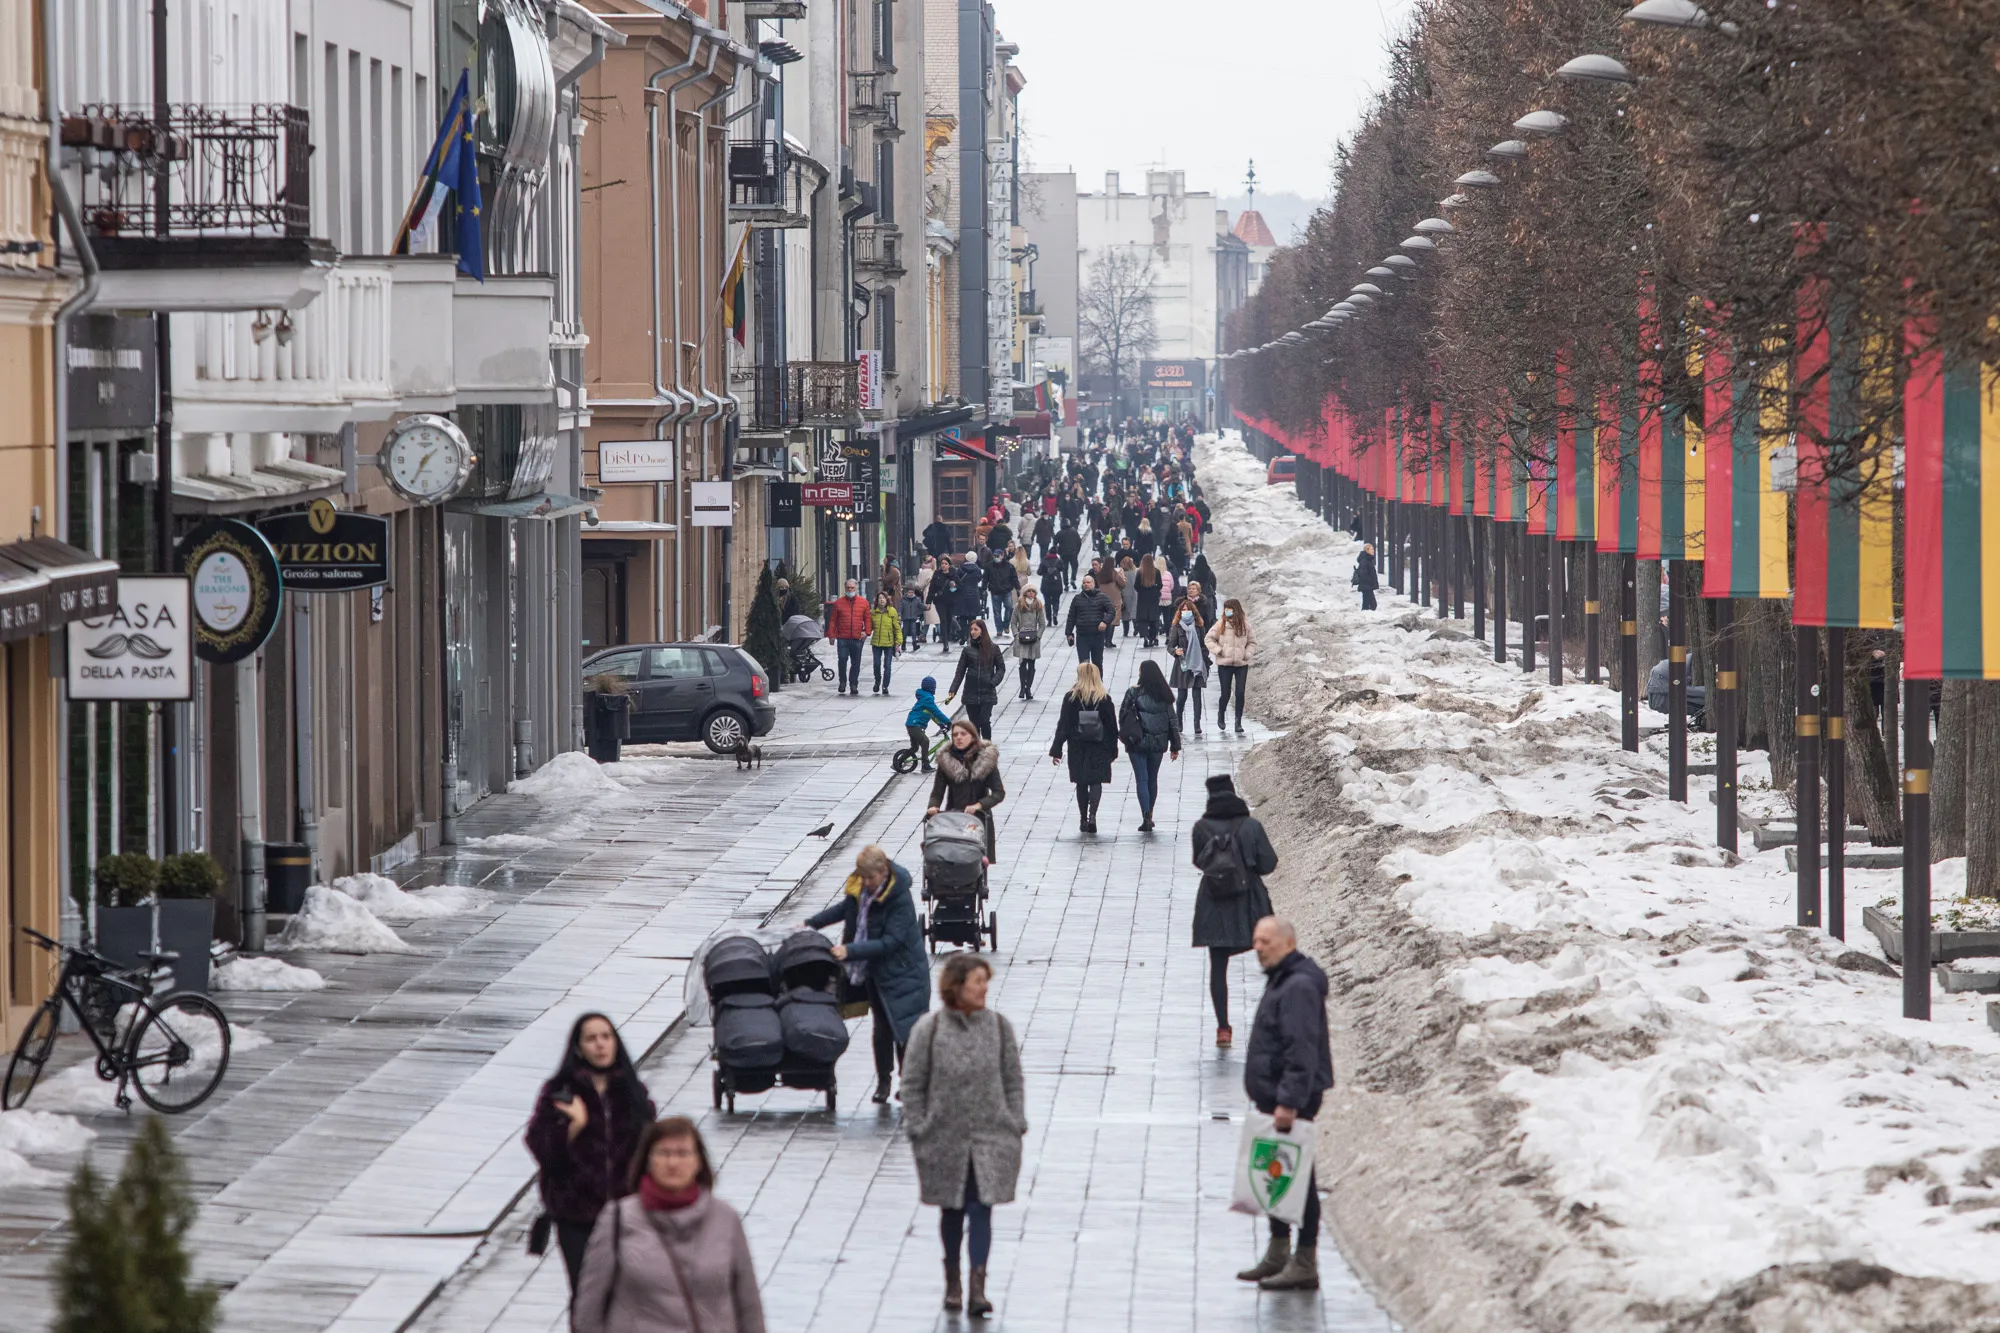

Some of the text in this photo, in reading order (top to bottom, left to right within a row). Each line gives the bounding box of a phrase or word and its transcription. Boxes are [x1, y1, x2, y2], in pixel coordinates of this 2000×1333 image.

[859, 354, 869, 409] IGVEDA
[822, 463, 846, 475] VERO
[314, 509, 330, 529] V
[273, 543, 377, 562] VIZION
[212, 575, 232, 584] THE
[322, 568, 363, 579] salonas
[80, 666, 175, 679] DELLA PASTA
